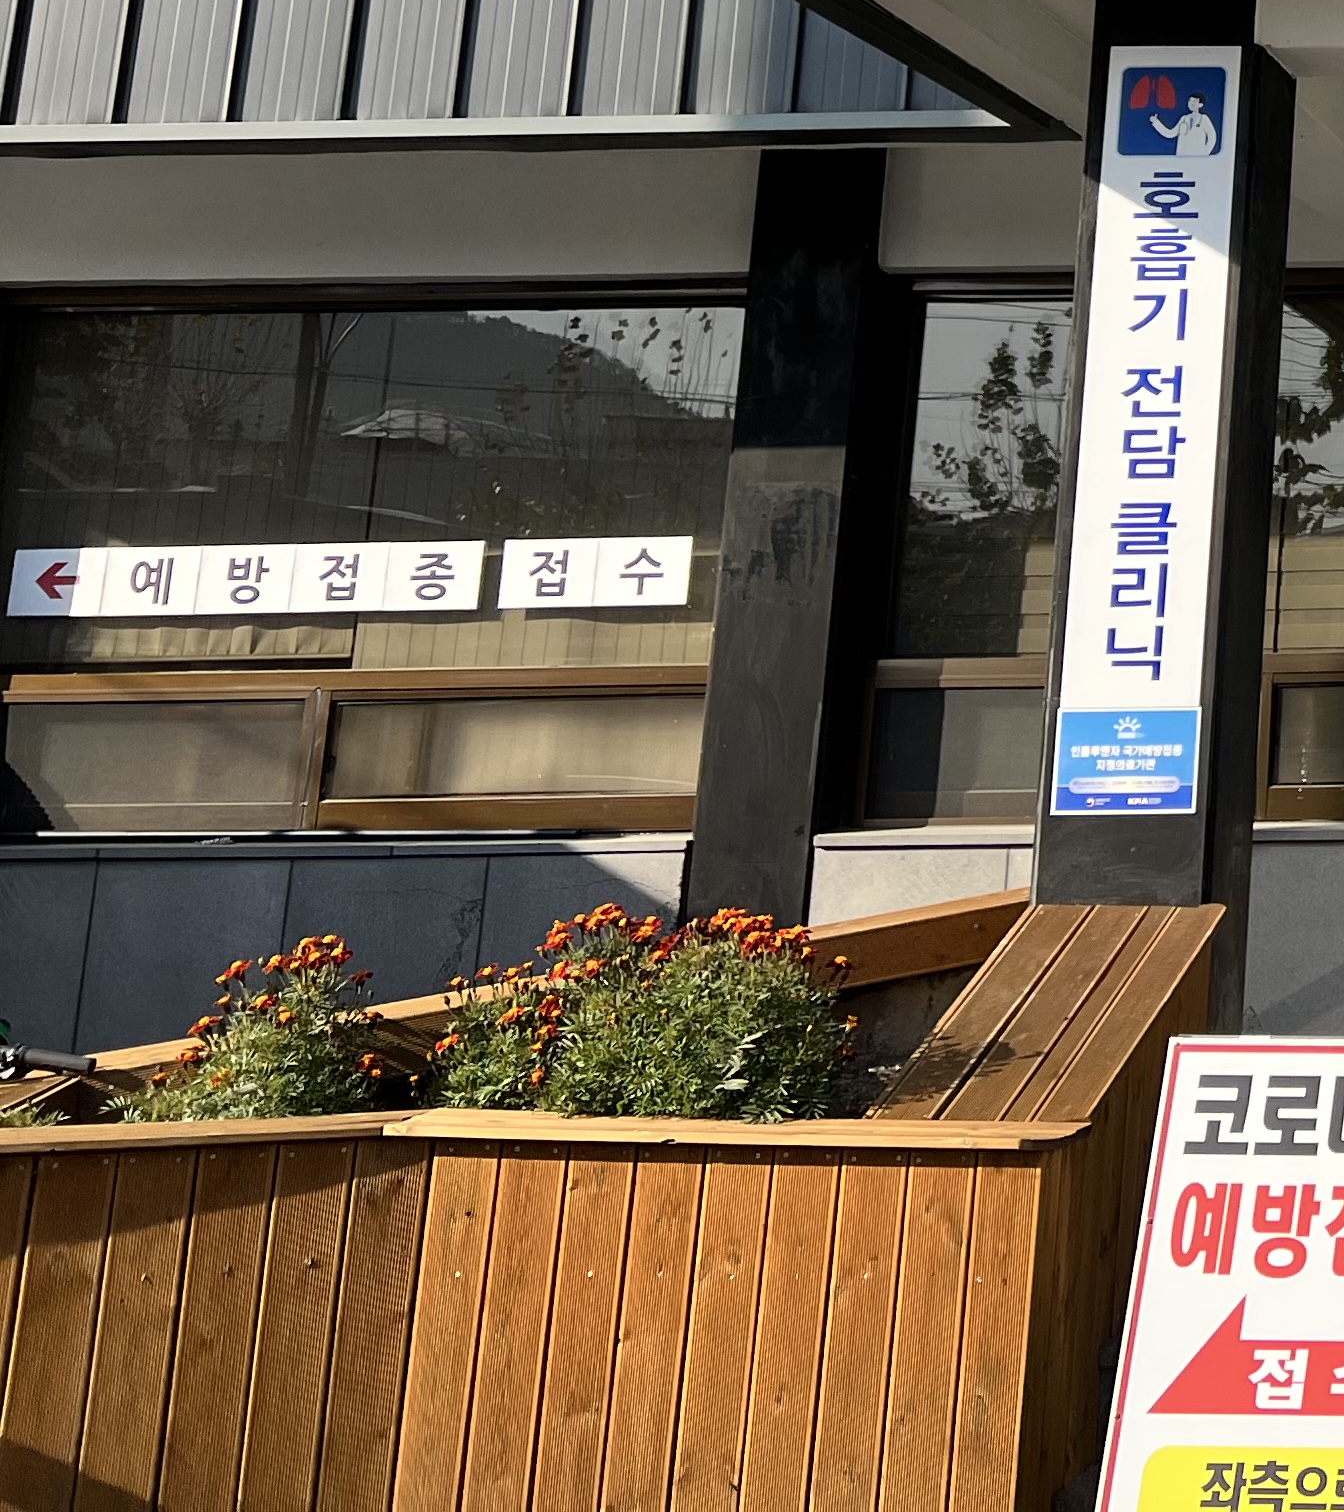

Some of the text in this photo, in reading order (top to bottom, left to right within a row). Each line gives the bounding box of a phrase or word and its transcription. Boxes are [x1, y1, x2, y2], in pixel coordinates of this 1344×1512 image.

[1105, 170, 1199, 682] 호흡기 전담 클리닉
[129, 548, 665, 606] 예방접종 접수
